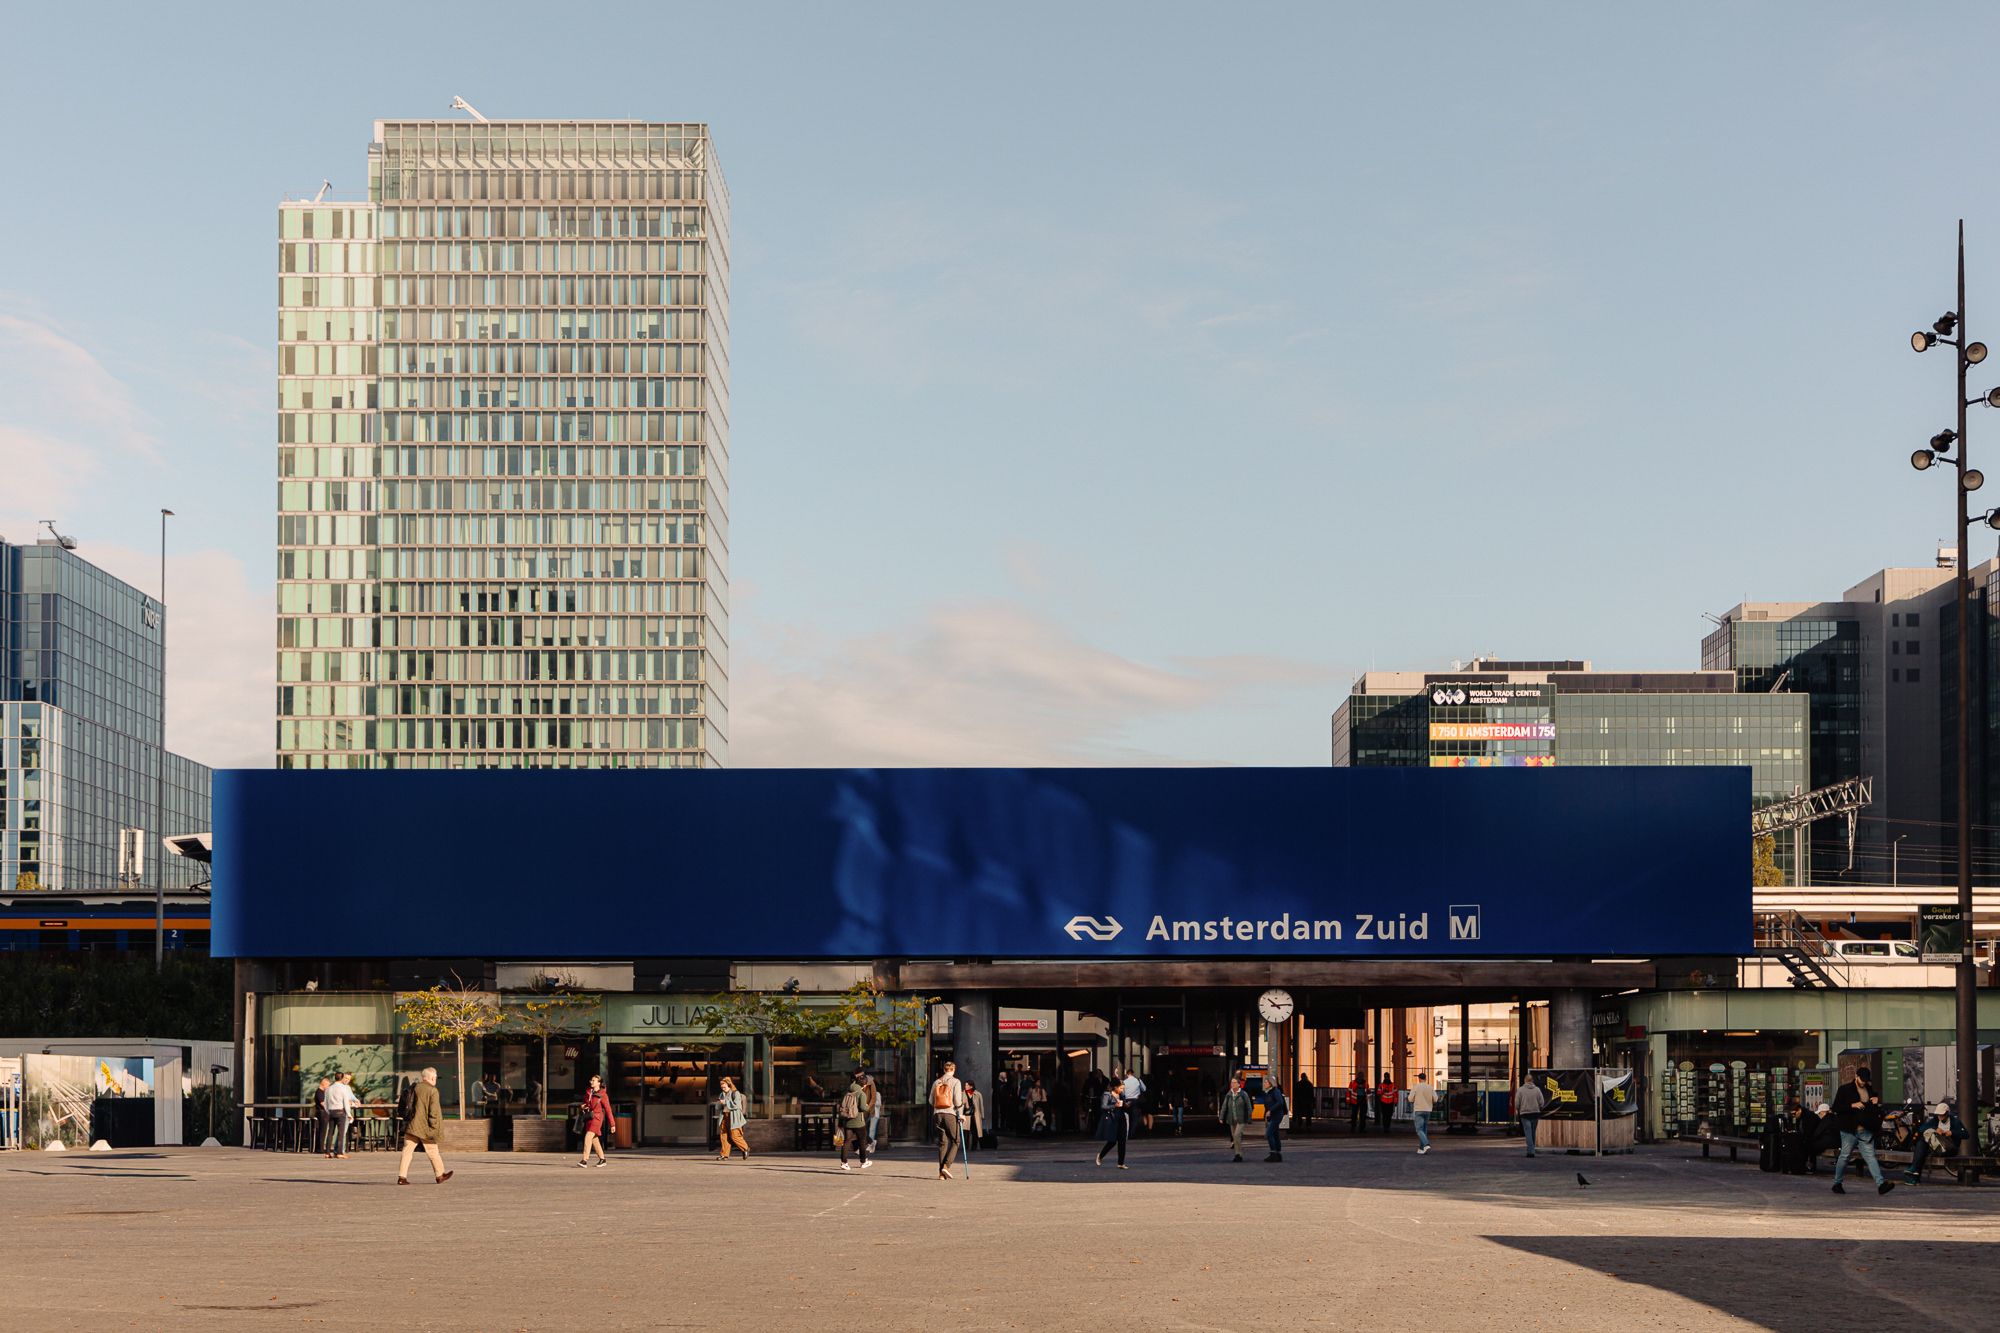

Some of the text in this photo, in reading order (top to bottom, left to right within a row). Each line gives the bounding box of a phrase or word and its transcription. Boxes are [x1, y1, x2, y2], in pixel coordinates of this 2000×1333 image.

[1438, 726, 1457, 737] 750
[1465, 726, 1531, 737] AMSTERDAM
[1538, 726, 1555, 737] 750
[1145, 912, 1477, 941] Amsterdam Zuid M
[171, 929, 178, 938] 2
[565, 1047, 579, 1059] illy
